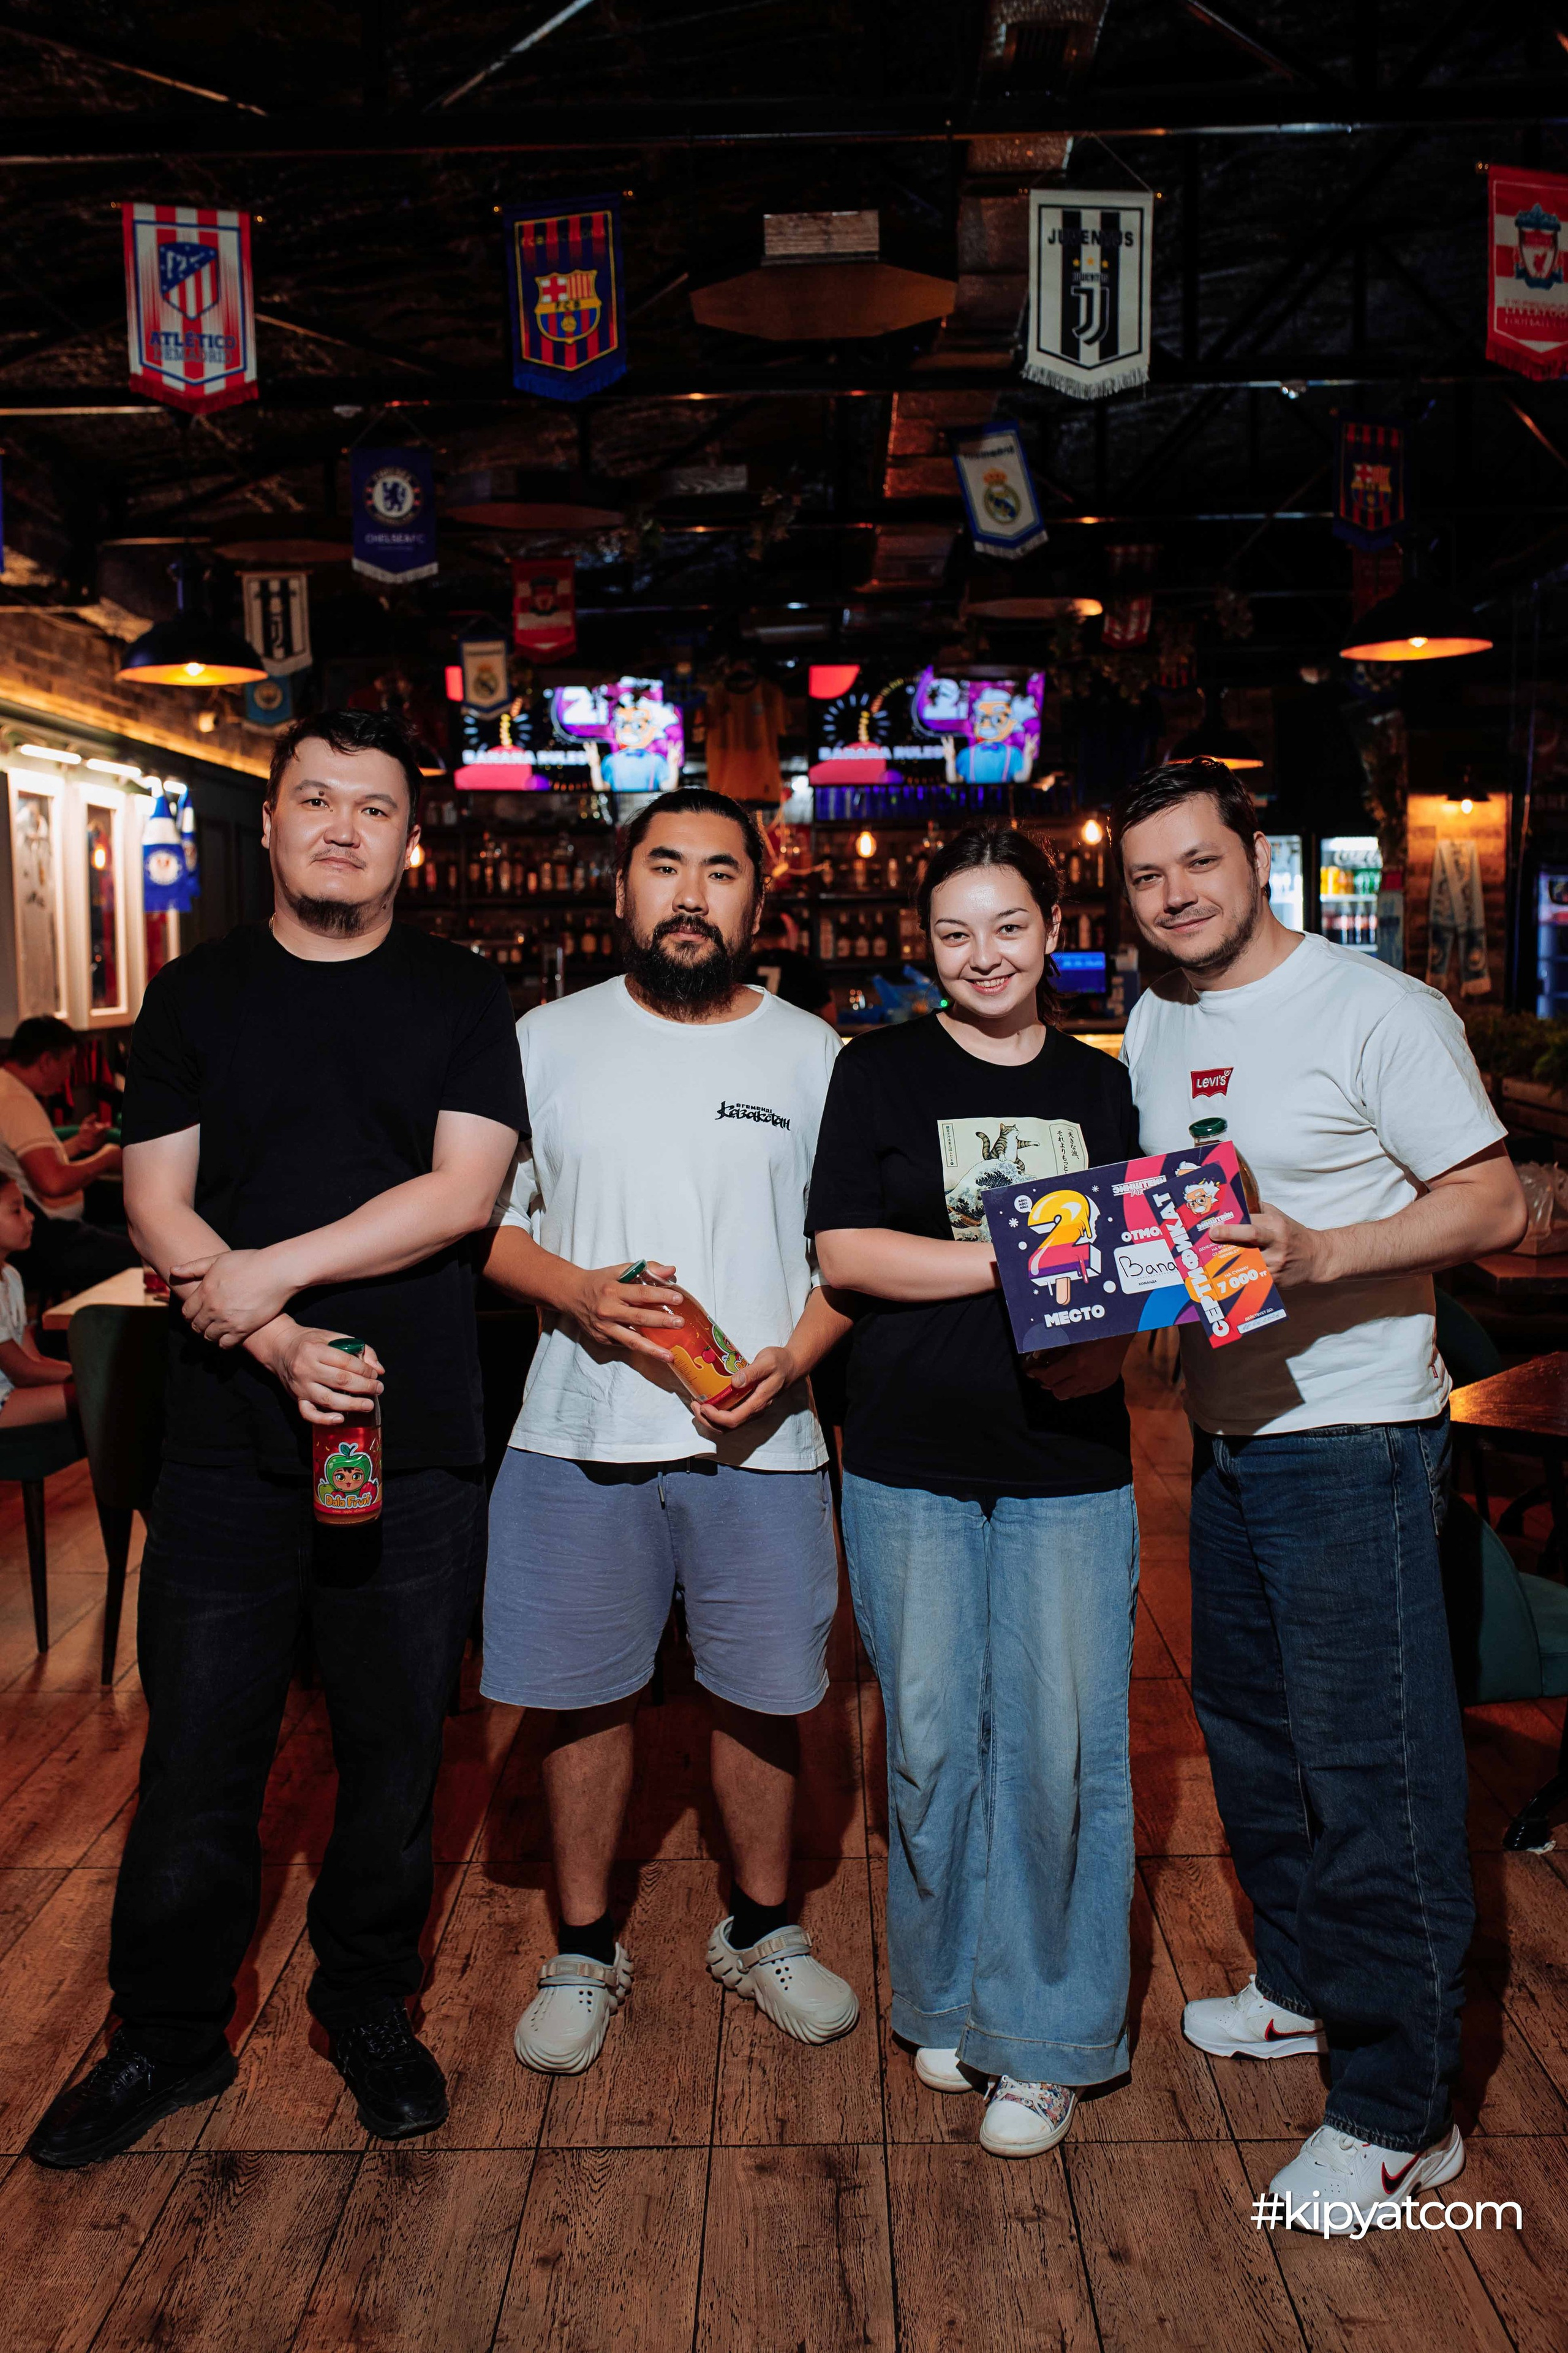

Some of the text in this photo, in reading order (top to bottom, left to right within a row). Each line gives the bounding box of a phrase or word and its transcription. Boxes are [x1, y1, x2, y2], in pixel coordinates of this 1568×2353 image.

[1048, 229, 1134, 246] JUVENTUS
[1121, 1226, 1163, 1242] ОТМО
[1152, 1192, 1230, 1338] СЕРТИФИКАТ
[1216, 1280, 1226, 1294] 7
[1044, 1304, 1106, 1328] МЕСТО
[325, 1493, 372, 1508] Dala Fruit
